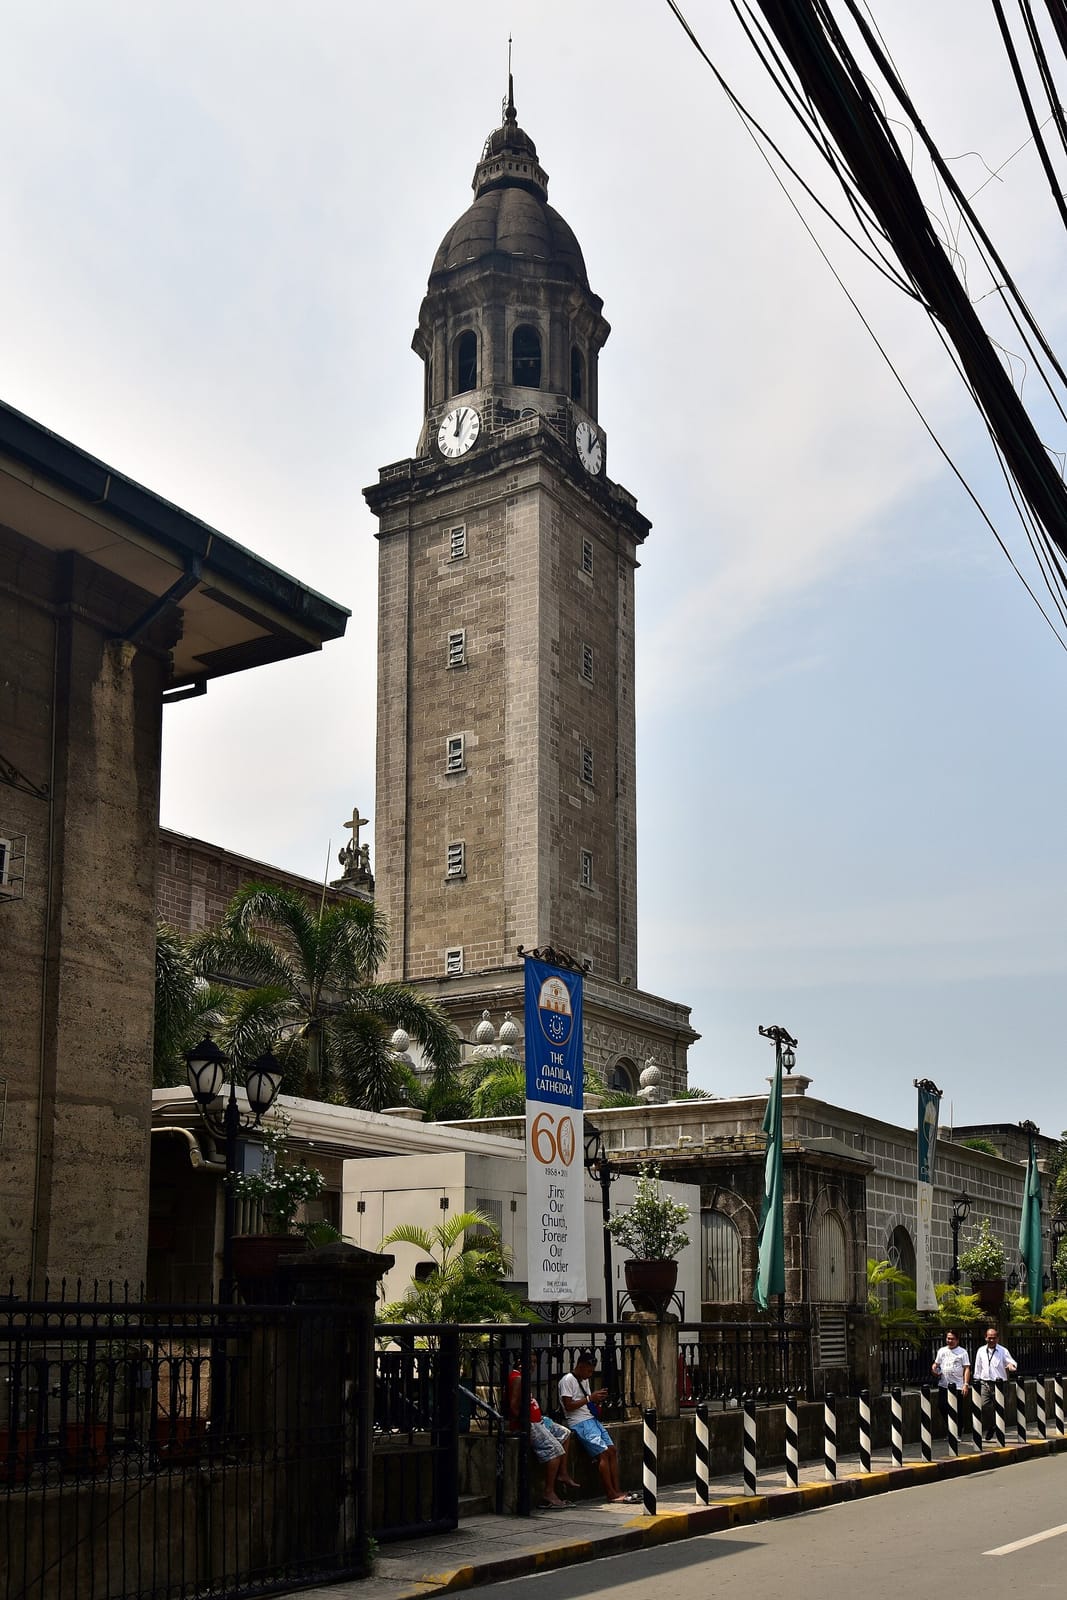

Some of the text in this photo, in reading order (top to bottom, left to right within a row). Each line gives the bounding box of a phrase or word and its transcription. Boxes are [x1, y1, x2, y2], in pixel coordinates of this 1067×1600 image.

[550, 1051, 564, 1066] THE
[541, 1064, 572, 1082] MANILA
[535, 1077, 574, 1097] CATHEDRA
[531, 1111, 575, 1167] 60
[549, 1199, 564, 1213] Our
[541, 1228, 568, 1243] Foreer
